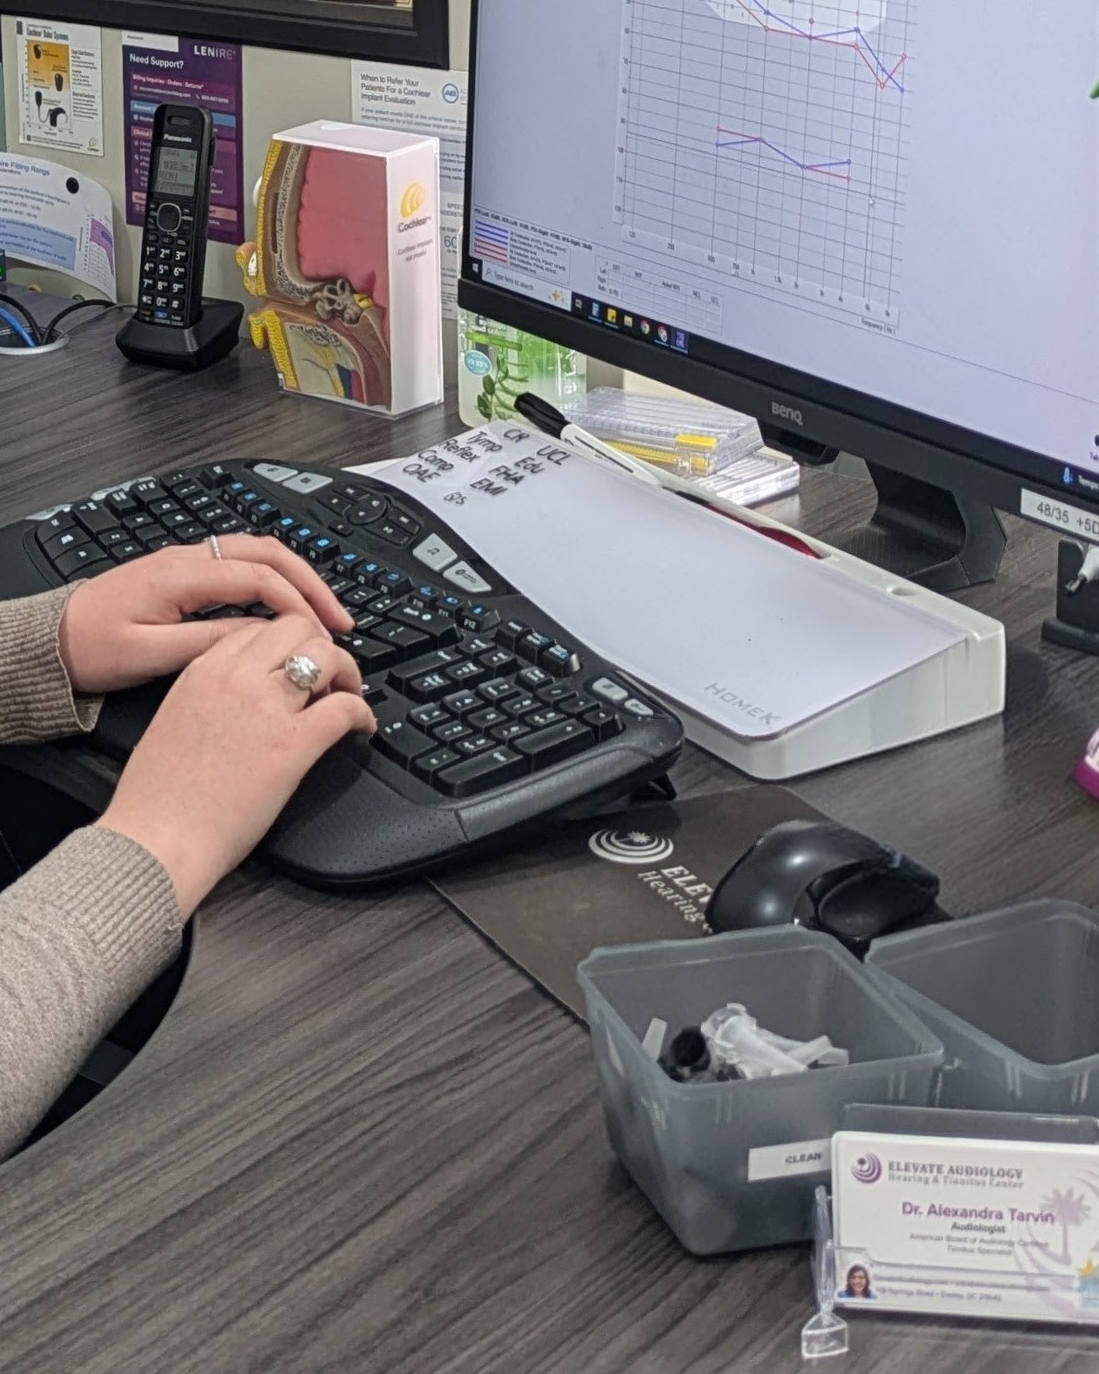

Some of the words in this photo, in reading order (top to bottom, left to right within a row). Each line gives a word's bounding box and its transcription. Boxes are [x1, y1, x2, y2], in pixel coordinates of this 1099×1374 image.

[194, 45, 232, 60] LENIRE
[129, 53, 149, 65] Need
[150, 57, 184, 69] Support?
[133, 74, 146, 82] Billing
[167, 79, 182, 87] Orders
[387, 76, 403, 85] Refer
[405, 78, 419, 86] Your
[361, 83, 385, 92] Patients
[403, 88, 431, 98] Cochlear
[361, 93, 383, 101] Implant
[384, 95, 416, 105] Evaluation
[163, 134, 192, 143] Panasonic
[11, 162, 29, 172] Fitting
[31, 166, 50, 176] Range
[398, 217, 429, 233] Cochlear
[494, 271, 505, 279] Type
[505, 275, 513, 283] here
[772, 402, 803, 426] BenQ
[438, 438, 481, 464] Reflex
[467, 431, 503, 453] Tymp
[514, 456, 546, 474] Edu
[536, 445, 573, 466] UCL
[402, 462, 441, 483] OAE
[417, 449, 455, 472] Comp
[470, 478, 508, 496] EMI
[1037, 502, 1069, 524] 48/35
[413, 598, 424, 608] F10
[438, 609, 449, 617] F11
[464, 618, 476, 629] F12
[704, 682, 782, 725] HOMEK
[637, 870, 706, 923] Hearing
[785, 1151, 823, 1165] CLEAN
[888, 1161, 944, 1175] ELEVATE
[947, 1165, 1023, 1179] AUDIOLOGY
[888, 1173, 929, 1185] Hearing
[943, 1176, 986, 1187] Tinnitus
[988, 1178, 1024, 1189] Center
[901, 1201, 923, 1215] Dr.
[927, 1203, 1004, 1221] Alexandra
[1008, 1208, 1056, 1224] Tarvin
[951, 1222, 1006, 1235] Audiologist
[909, 1233, 944, 1241] American
[979, 1237, 1015, 1247] Audiology
